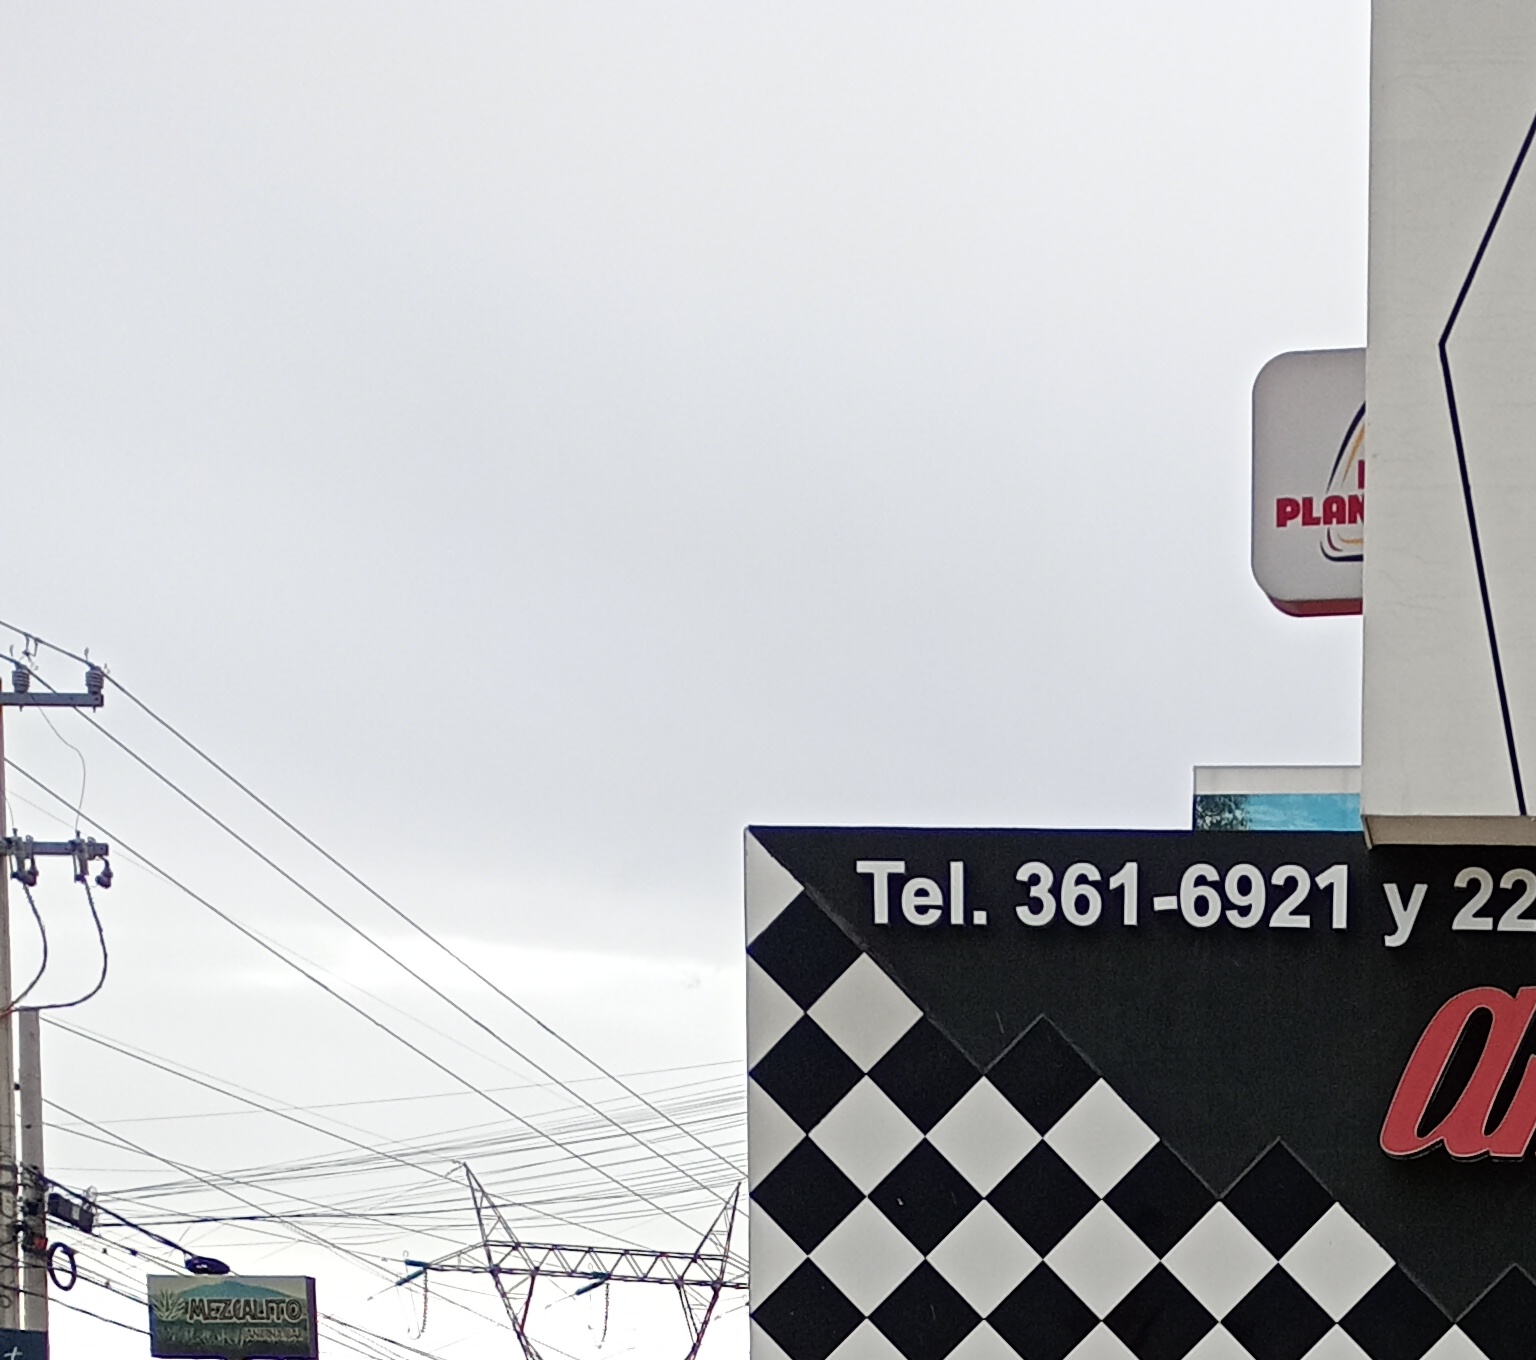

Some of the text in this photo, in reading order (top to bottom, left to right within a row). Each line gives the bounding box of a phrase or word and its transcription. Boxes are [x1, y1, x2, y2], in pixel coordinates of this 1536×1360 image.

[856, 861, 987, 926] Tel.
[1015, 861, 1350, 929] 361-6921
[1383, 881, 1428, 947] y
[187, 1298, 304, 1322] MEZCALITO
